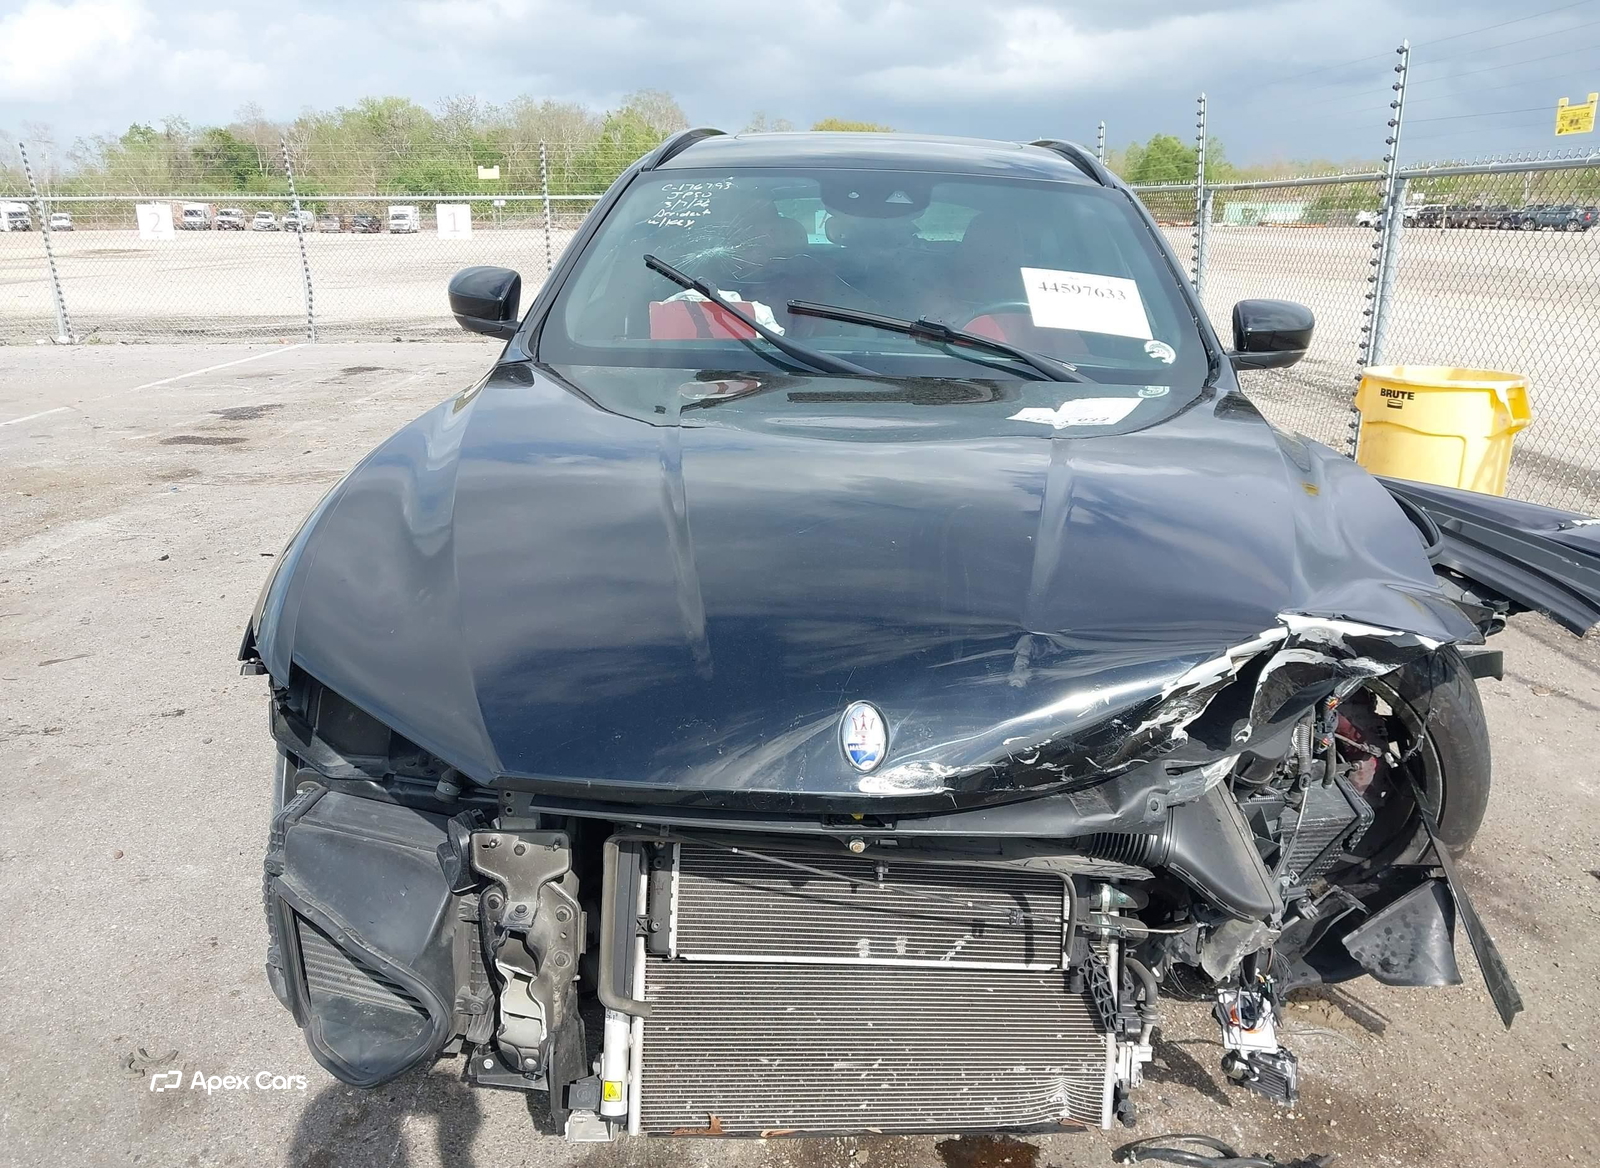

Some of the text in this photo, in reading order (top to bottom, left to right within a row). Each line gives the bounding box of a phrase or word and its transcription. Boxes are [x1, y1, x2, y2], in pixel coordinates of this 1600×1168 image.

[149, 212, 163, 232] 2
[448, 212, 460, 232] 1
[1038, 281, 1126, 300] 44597633
[1380, 387, 1415, 401] BRUTE
